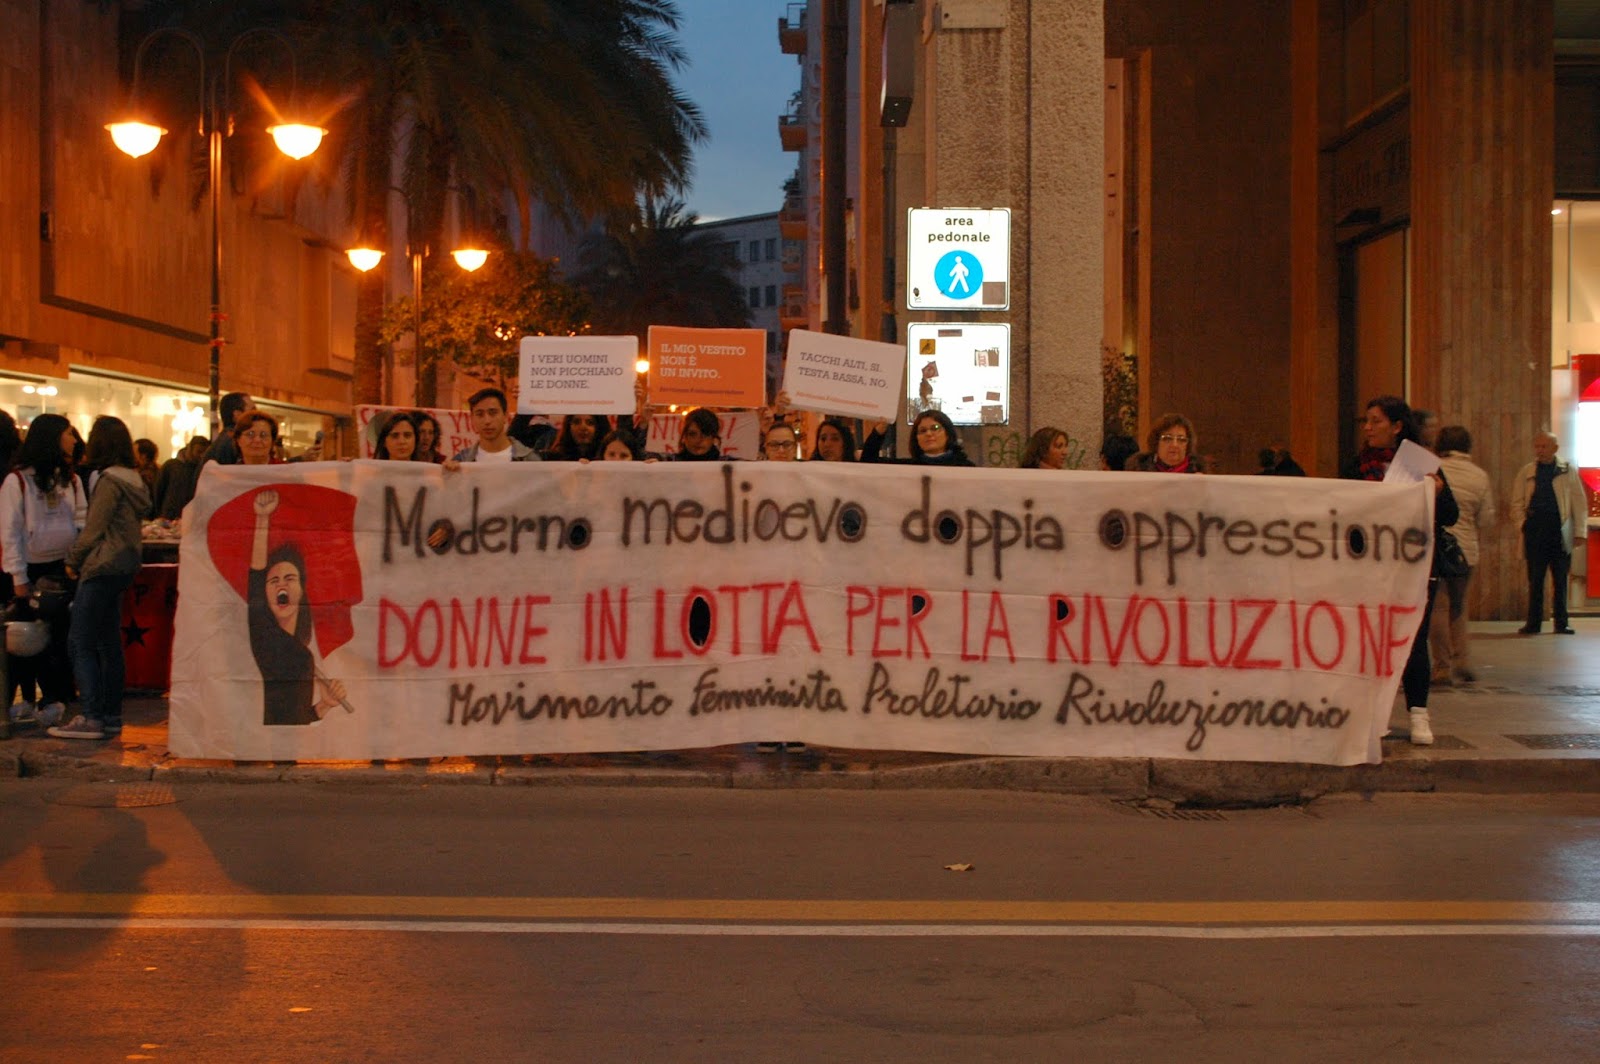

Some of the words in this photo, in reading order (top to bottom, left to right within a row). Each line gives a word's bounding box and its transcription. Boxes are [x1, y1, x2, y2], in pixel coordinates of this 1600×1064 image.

[945, 217, 974, 226] area
[928, 231, 991, 243] pedonale
[661, 344, 671, 353] IL
[673, 344, 696, 354] MIO
[699, 345, 746, 355] VESTITO
[538, 355, 565, 363] VERI
[566, 355, 608, 363] UOMINI
[660, 356, 686, 366] NON
[800, 352, 841, 366] TACCHI
[531, 367, 556, 376] NON
[559, 367, 623, 376] PICCHIANO
[660, 368, 676, 377] UN
[679, 368, 721, 379] INVITO.
[798, 366, 830, 380] TESTA
[531, 380, 543, 389] LE
[546, 380, 590, 389] DONNE.
[383, 485, 592, 563] Moderno
[620, 464, 867, 546] medioevo
[901, 475, 1065, 580] doppia
[1099, 508, 1428, 585] oppressione
[378, 595, 552, 669] DONNE
[583, 587, 628, 662] IN
[653, 580, 822, 659] LOTTA
[846, 586, 932, 660] PER
[961, 588, 1017, 664] LA
[446, 680, 674, 726] Movimento
[862, 661, 1042, 720] Proletario
[1055, 672, 1351, 751] Rivoluzionario
